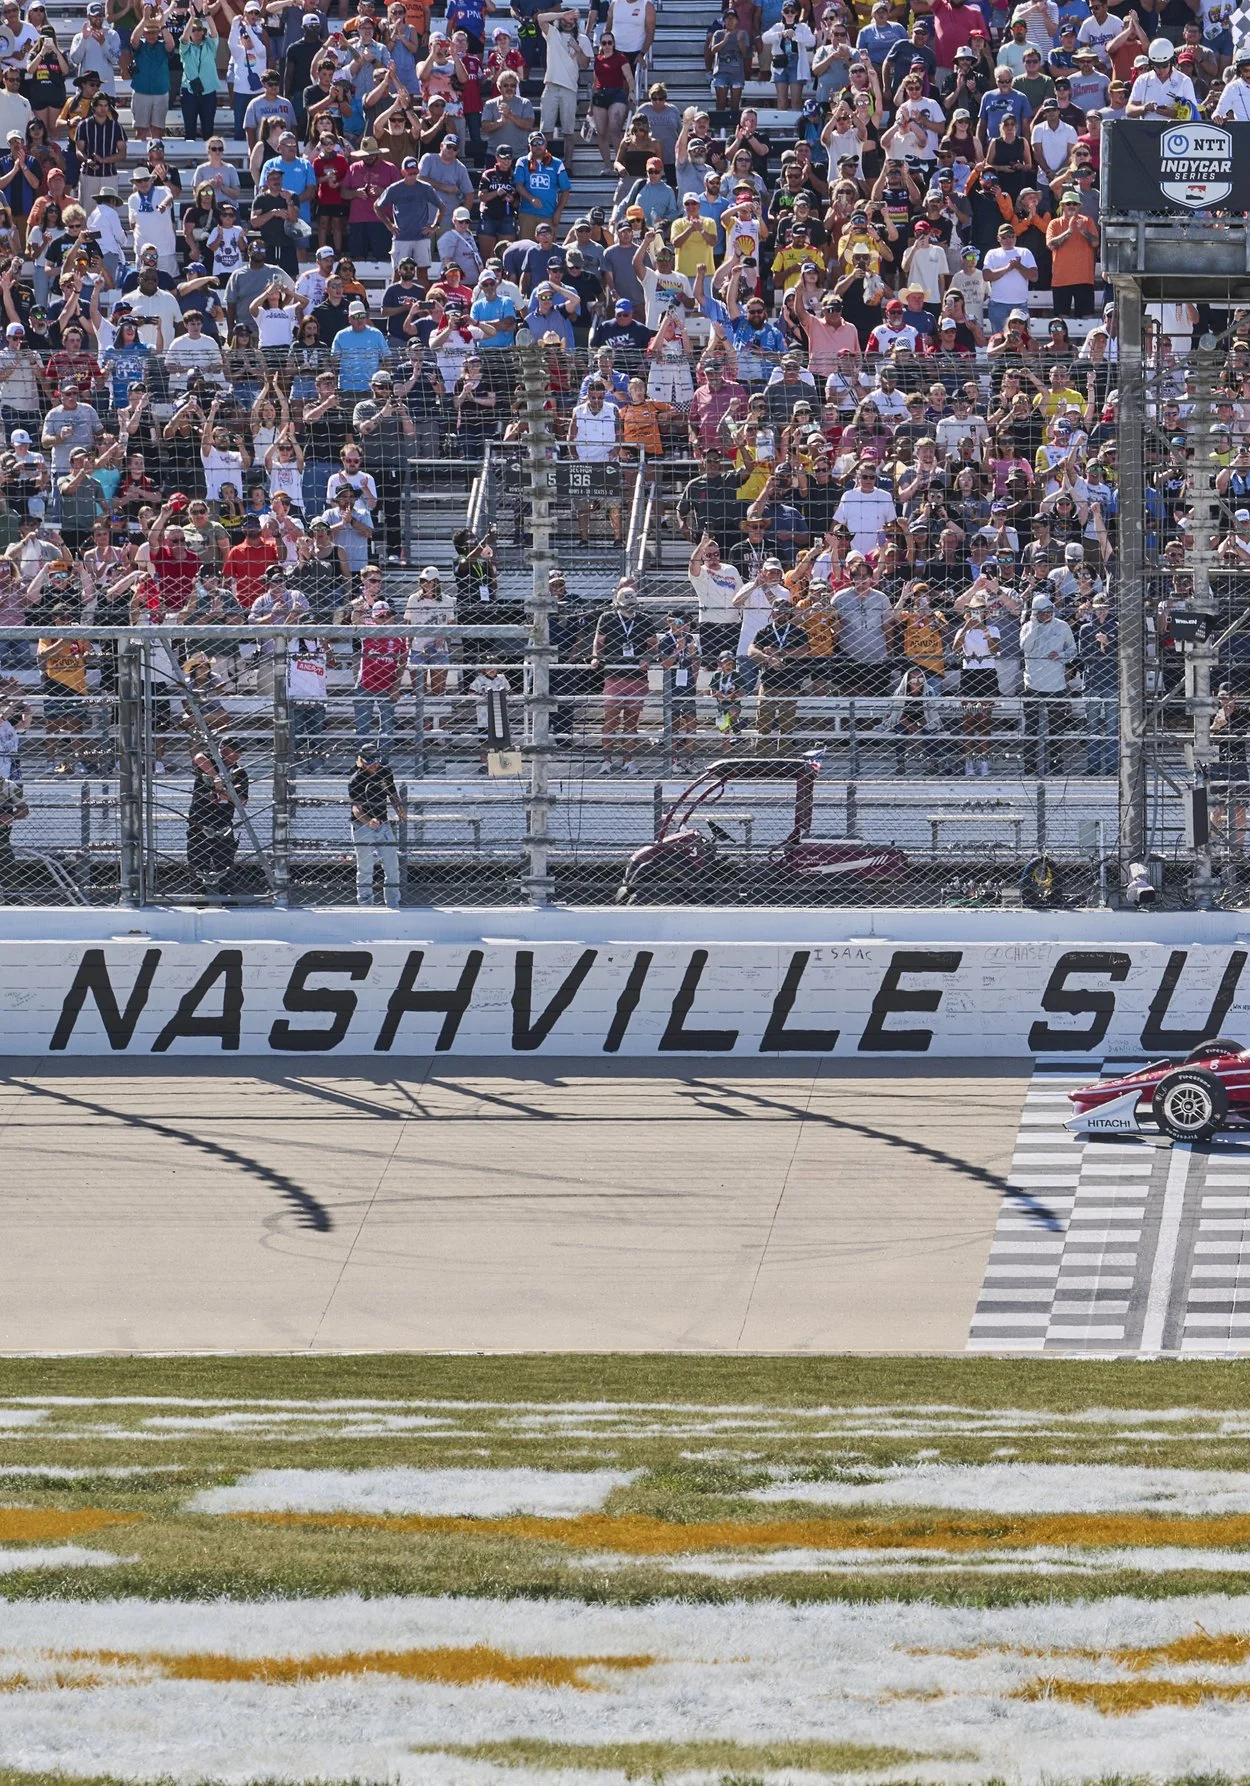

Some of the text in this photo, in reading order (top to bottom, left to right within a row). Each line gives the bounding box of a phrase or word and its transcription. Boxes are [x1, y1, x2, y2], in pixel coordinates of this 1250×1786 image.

[1193, 139, 1226, 151] NTT
[1160, 160, 1232, 173] INDYCAR
[533, 176, 549, 188] PPG
[1174, 172, 1216, 180] SERIES
[489, 183, 511, 191] HITAC
[569, 474, 591, 487] 136
[49, 949, 963, 1054] NASHVILLE
[1204, 1047, 1231, 1056] Firesto
[1178, 1074, 1211, 1089] Firestone
[1087, 1119, 1131, 1129] HITACHI
